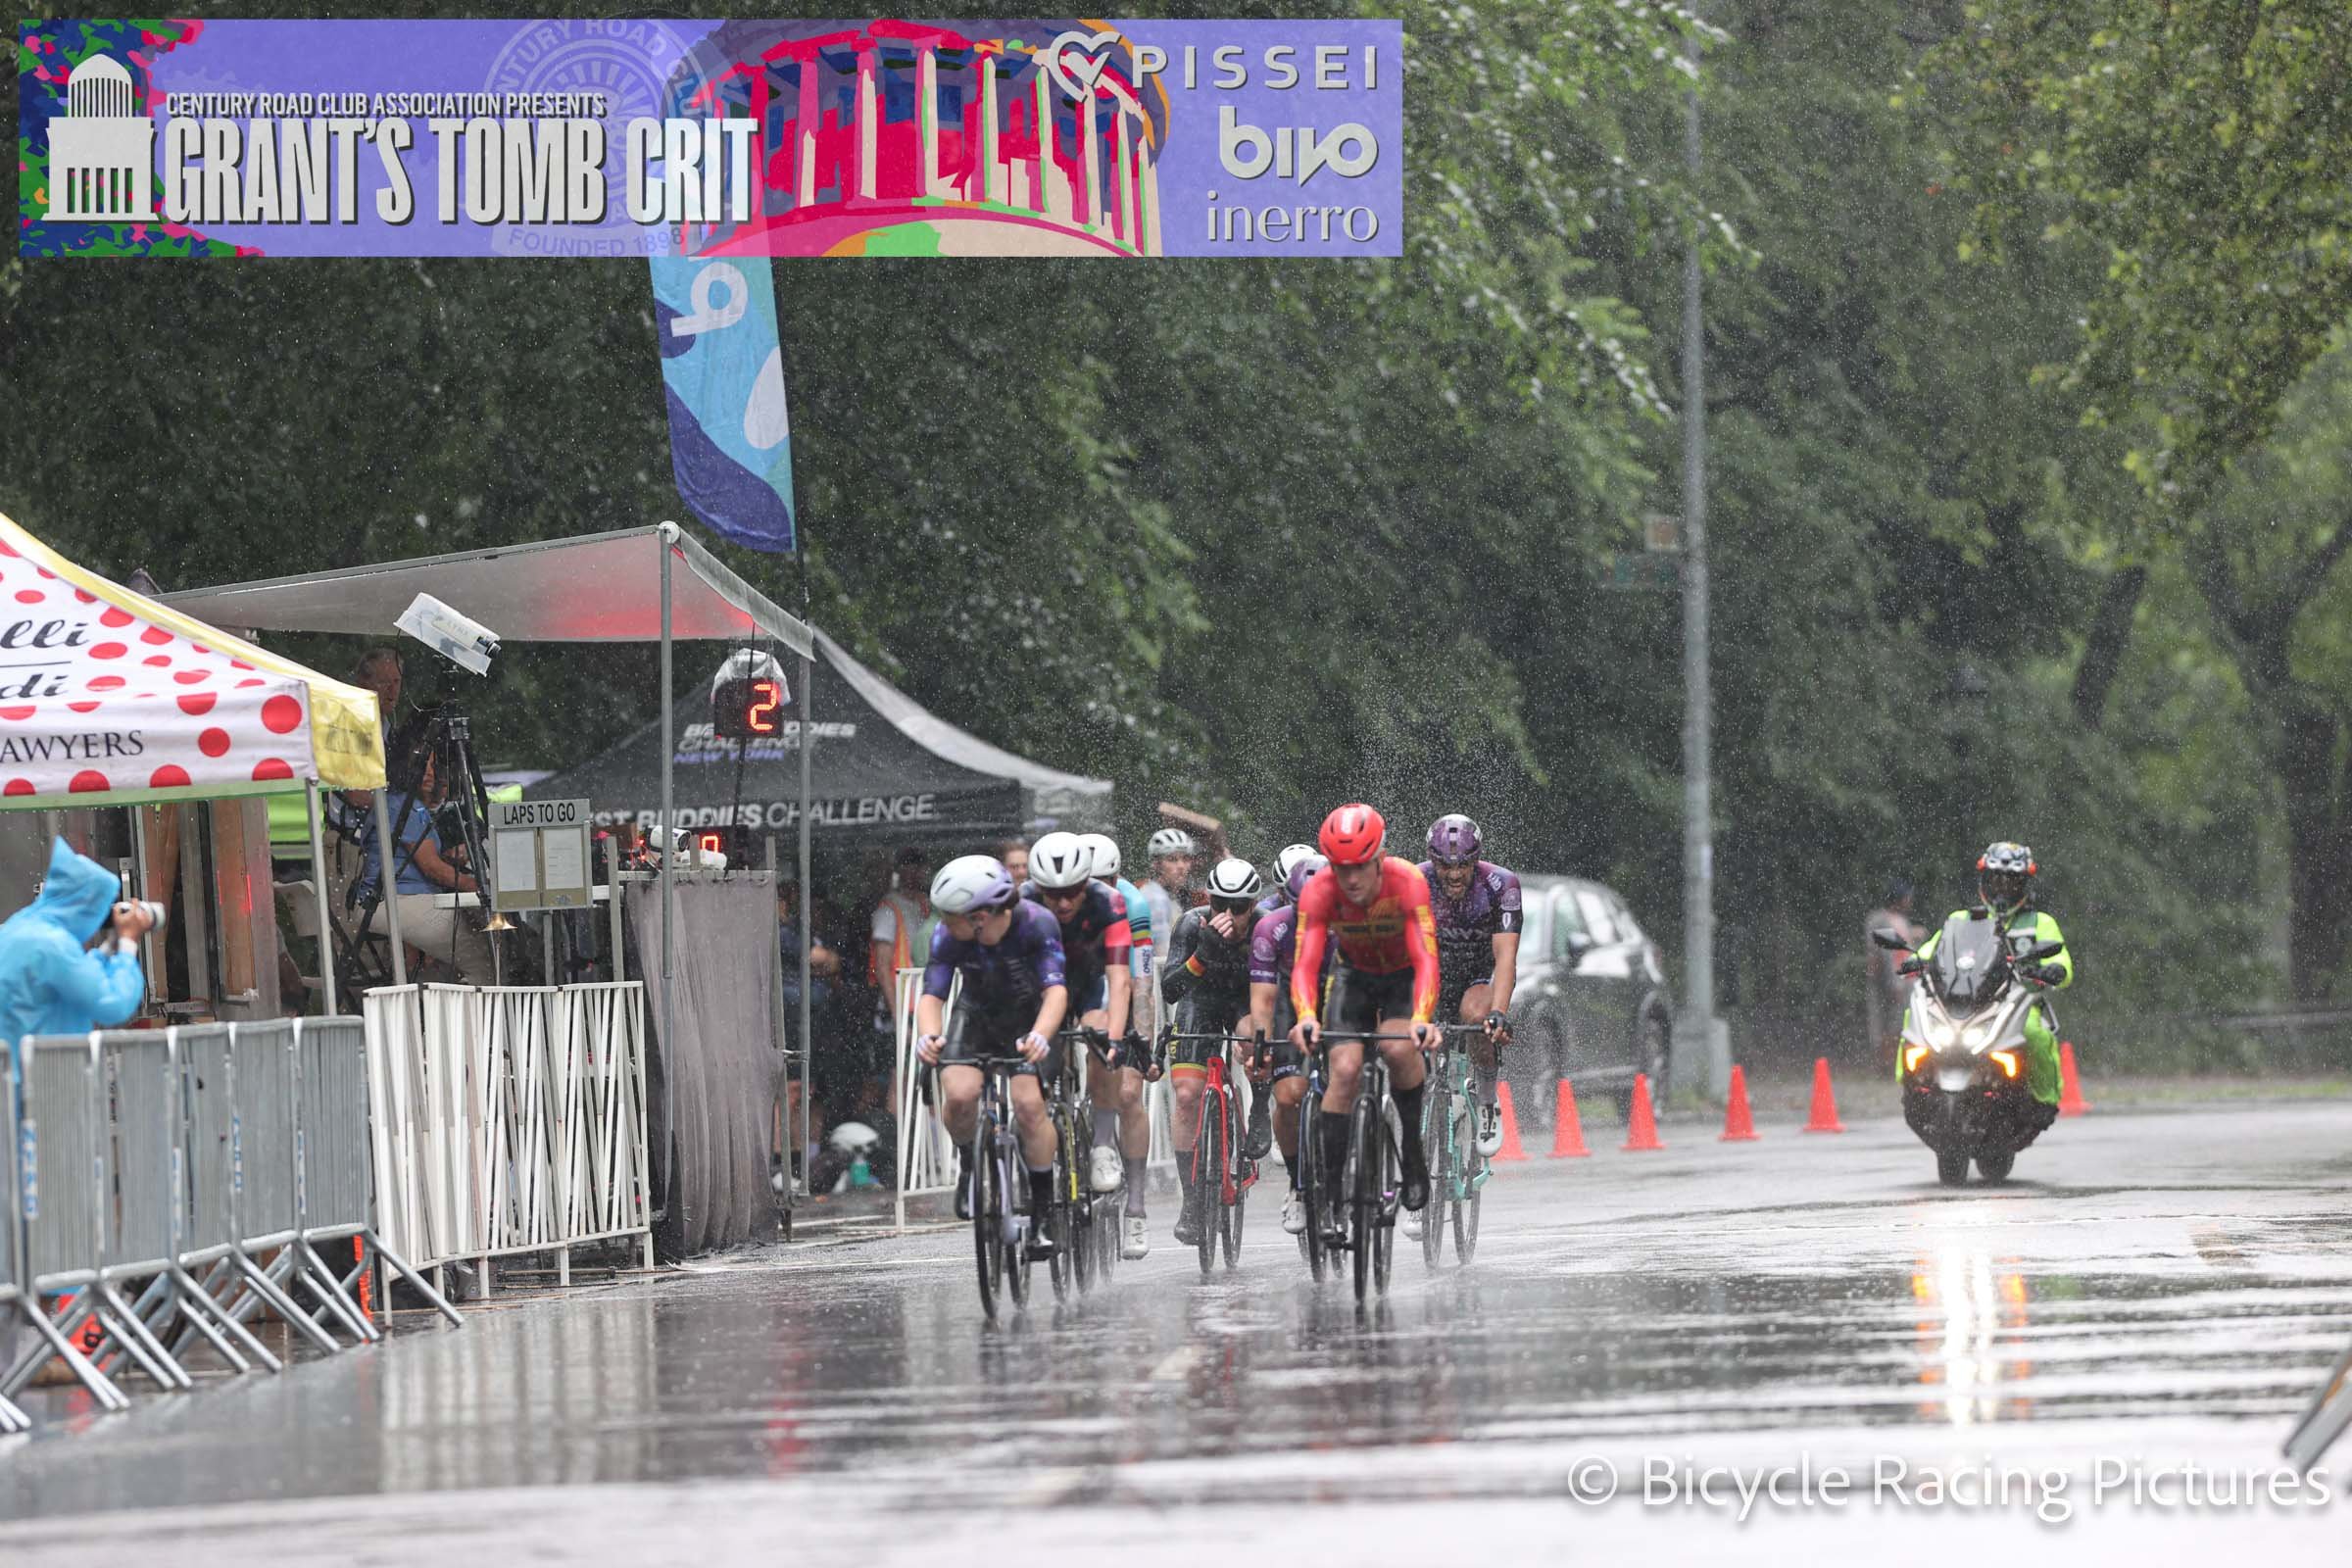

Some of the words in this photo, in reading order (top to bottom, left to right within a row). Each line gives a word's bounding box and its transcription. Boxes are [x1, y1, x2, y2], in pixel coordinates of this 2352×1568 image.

[749, 683, 778, 731] 2
[673, 752, 723, 764] NEW
[504, 805, 534, 824] LAPS
[537, 804, 554, 823] TO
[558, 803, 575, 822] GO
[766, 794, 935, 829] CHALLENGE
